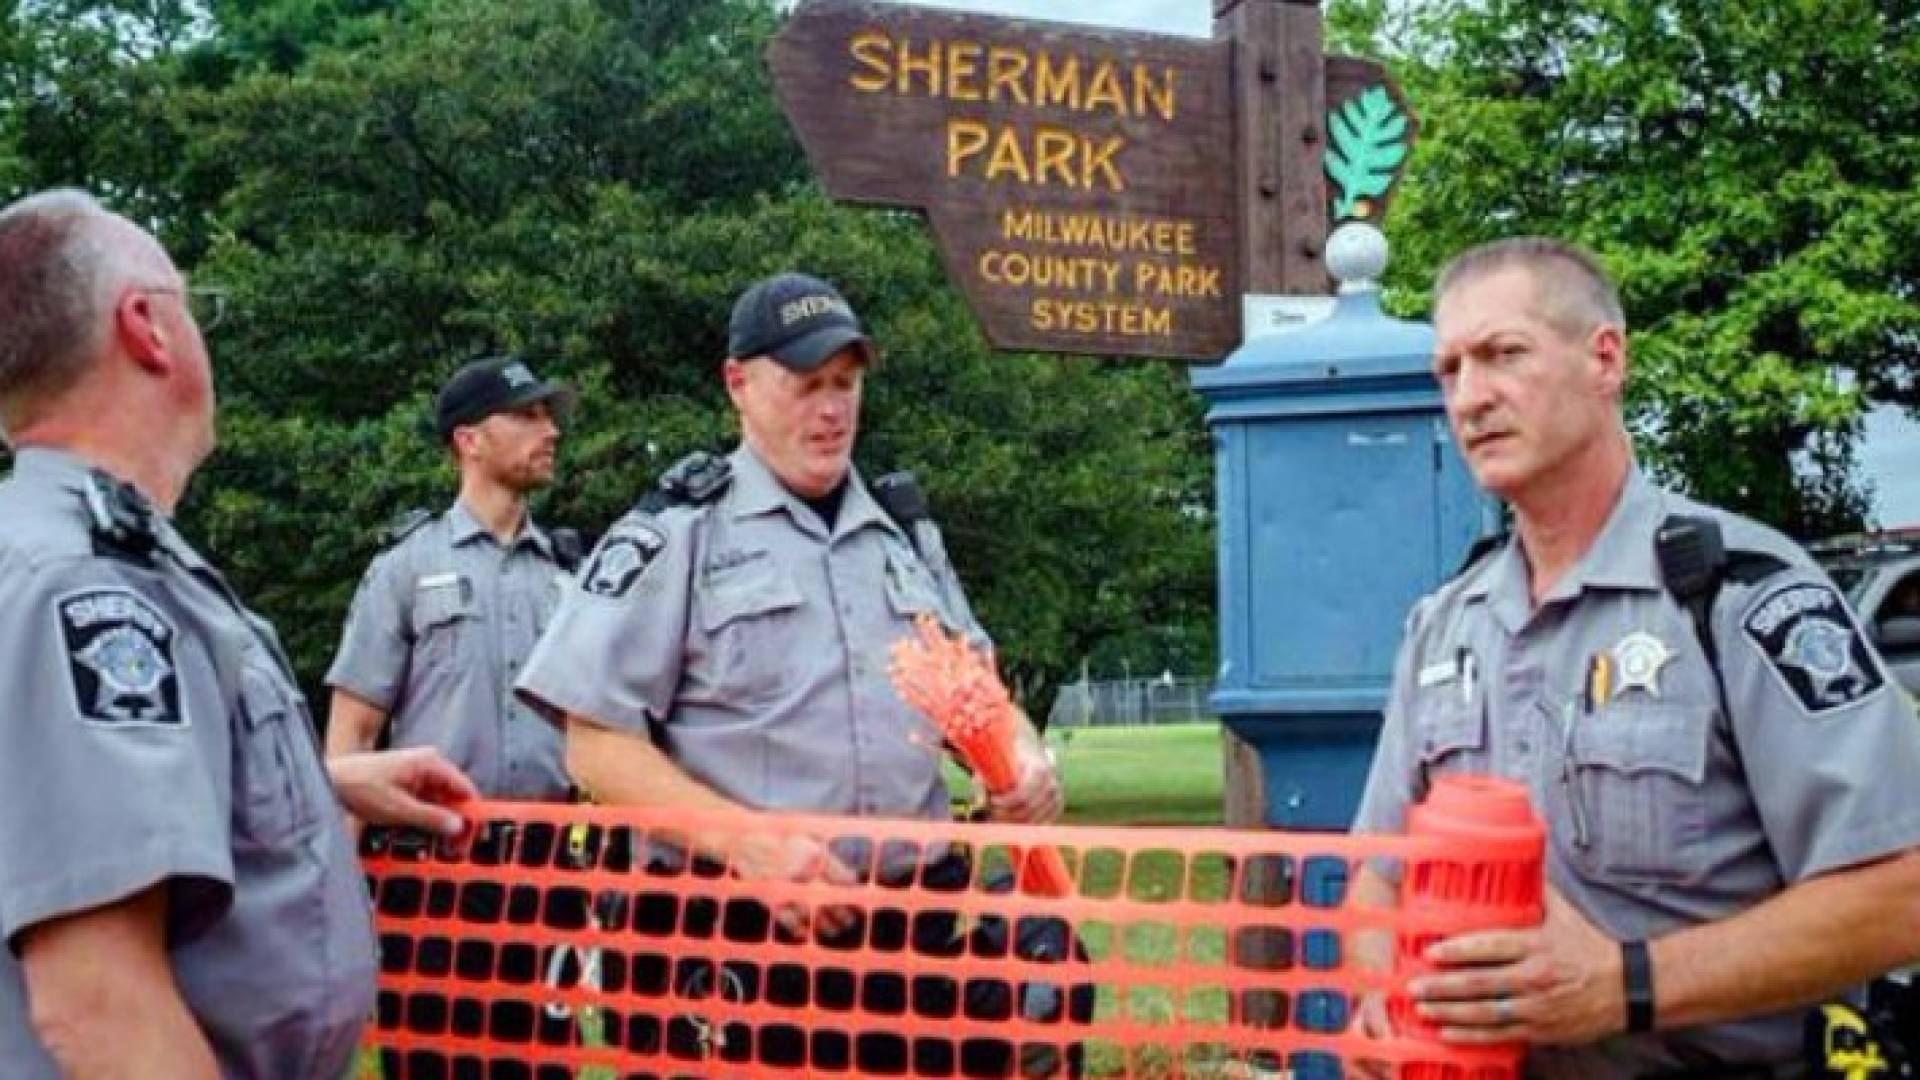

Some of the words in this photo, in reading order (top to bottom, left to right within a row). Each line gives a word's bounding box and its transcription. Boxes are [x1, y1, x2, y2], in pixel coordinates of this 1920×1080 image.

[850, 35, 1176, 120] SHERMAN
[948, 119, 1126, 192] PARK
[1003, 209, 1196, 255] MILWAUKEE
[979, 251, 1121, 291] COUNTY
[1136, 261, 1222, 298] PARK
[1031, 299, 1172, 335] SYSTEM
